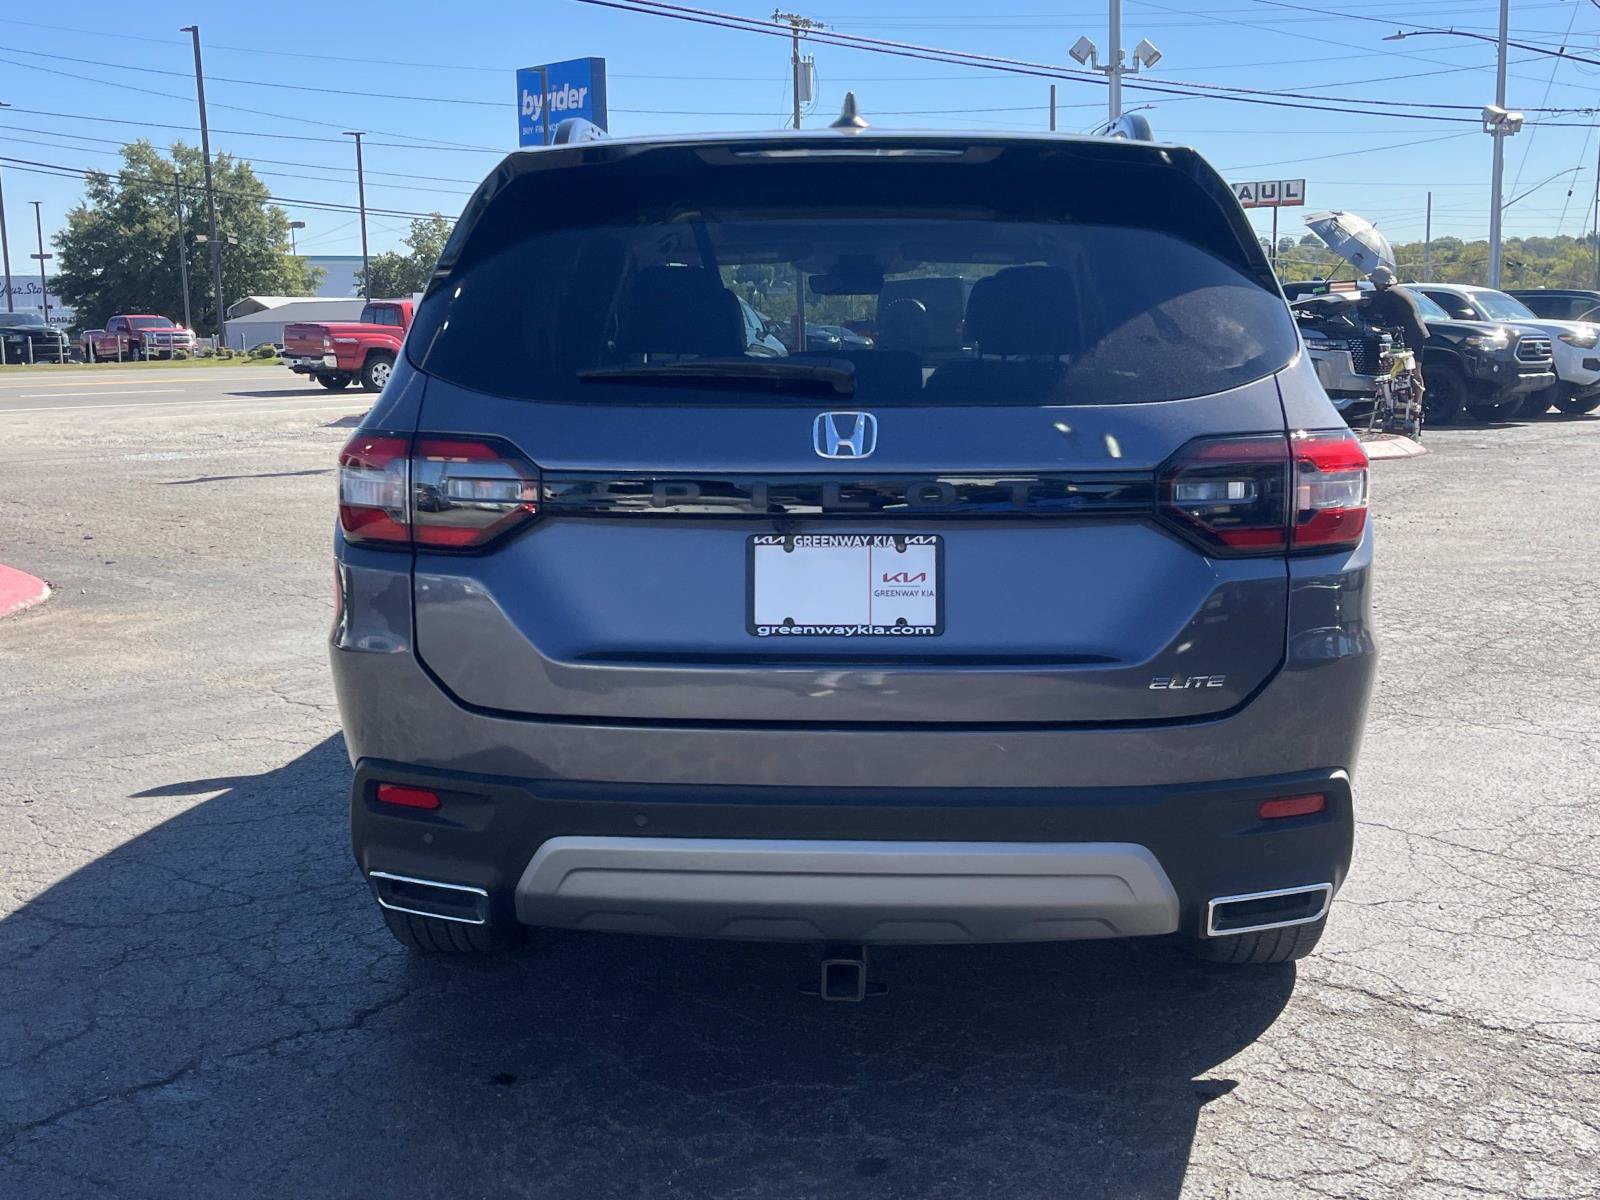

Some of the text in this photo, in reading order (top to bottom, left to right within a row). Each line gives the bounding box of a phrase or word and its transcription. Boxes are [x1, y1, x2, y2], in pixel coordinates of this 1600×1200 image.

[793, 535, 897, 548] GREENWAY KIA
[874, 589, 935, 598] GREENWAY KIA
[757, 624, 935, 637] greenwaykia.com
[1149, 674, 1227, 690] ELITE
